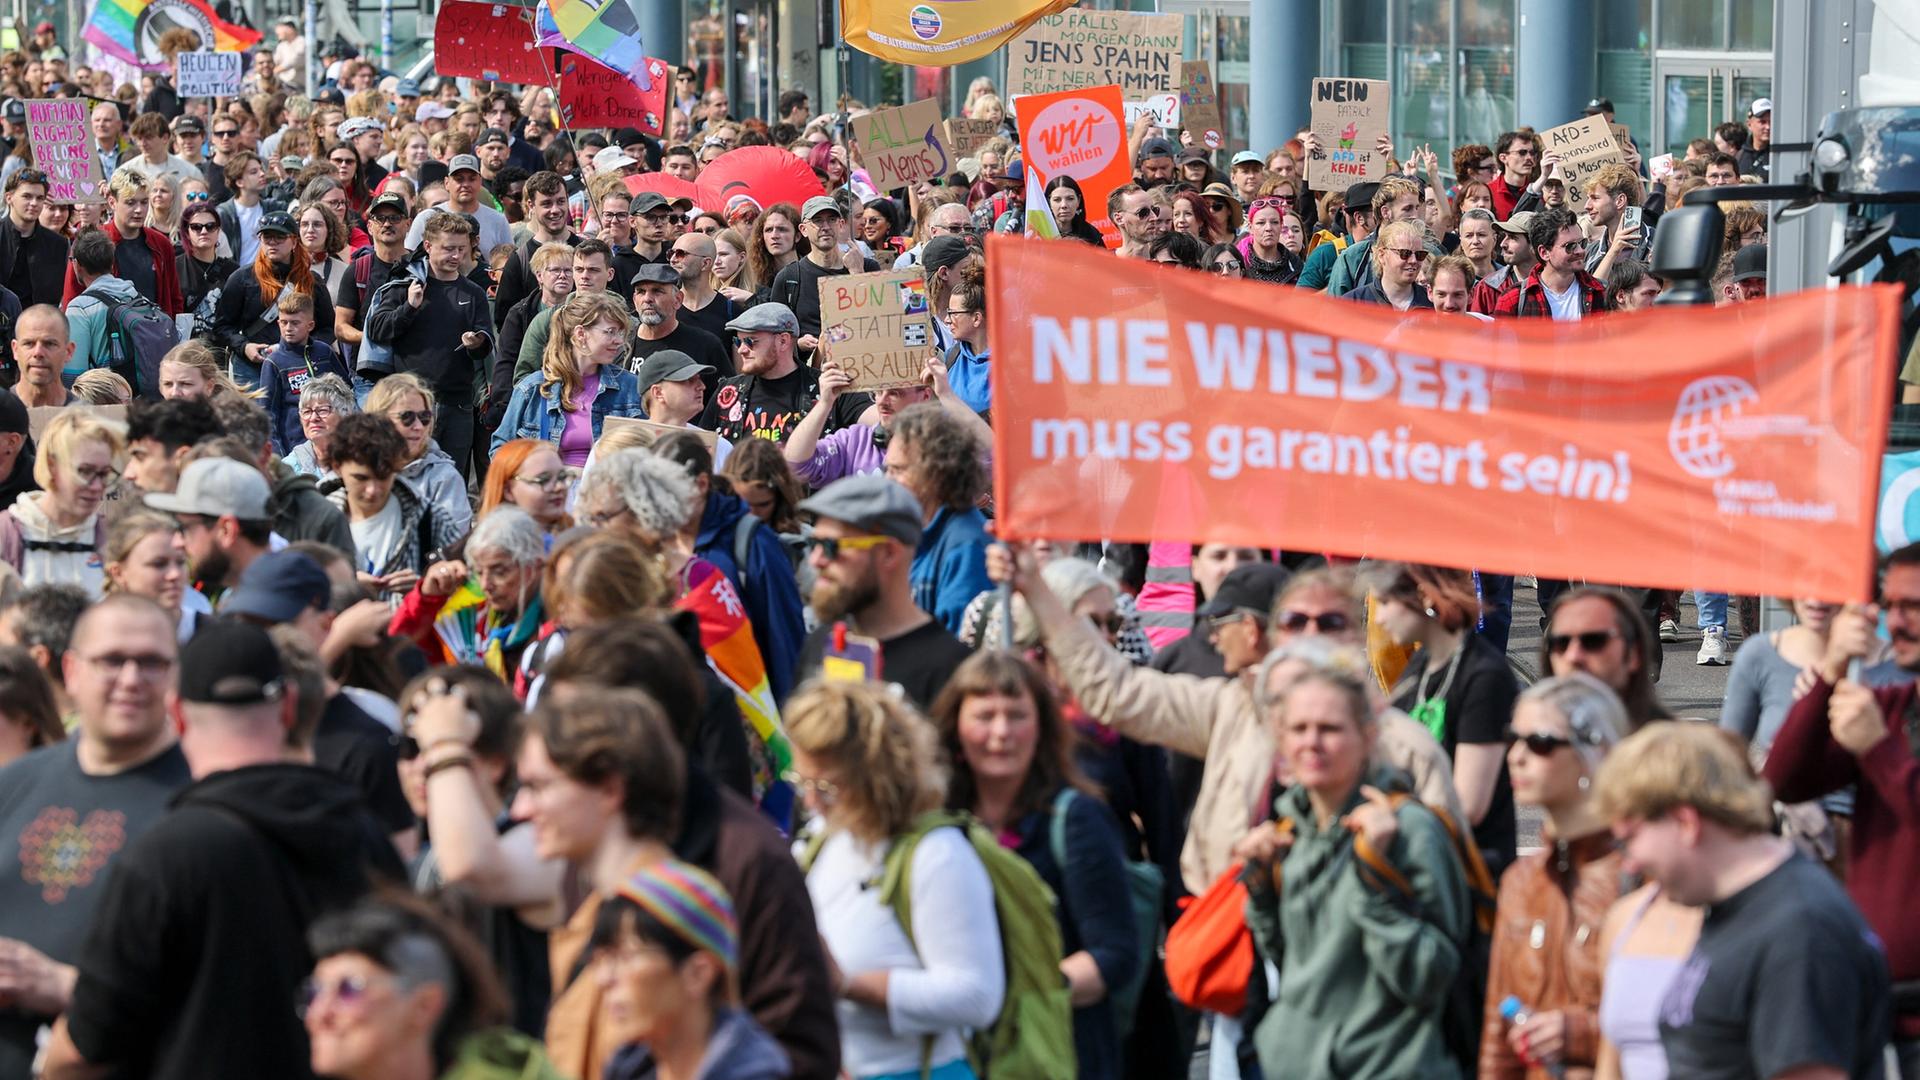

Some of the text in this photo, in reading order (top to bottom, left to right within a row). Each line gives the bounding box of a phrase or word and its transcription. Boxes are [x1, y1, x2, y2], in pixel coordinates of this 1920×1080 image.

[1034, 14, 1119, 30] ND FALLS
[1060, 31, 1179, 48] MORGEN DANN
[180, 53, 237, 72] HEULEN
[1024, 40, 1170, 72] JENS SPAHN
[1063, 70, 1097, 85] NER
[180, 82, 236, 97] POLITIK
[1317, 80, 1369, 103] NEIN
[28, 102, 85, 123] HUMAN
[573, 94, 600, 118] Mehr
[1337, 105, 1371, 118] PATRICK
[33, 124, 88, 142] RIGHTS
[868, 108, 924, 150] ALL
[1039, 105, 1105, 155] wir
[1552, 125, 1580, 147] AfD
[37, 143, 90, 161] BELONG
[956, 136, 969, 150] IST
[1560, 138, 1609, 163] sponsored
[1049, 145, 1104, 170] wählen
[1313, 151, 1371, 162] Die AFD ist
[48, 162, 89, 180] EVERY
[1331, 162, 1367, 176] KEINE
[1563, 166, 1577, 182] by
[49, 182, 78, 200] ONE
[836, 280, 909, 311] BUNT
[842, 315, 905, 342] STATT
[842, 350, 924, 381] BRAUN
[1032, 316, 1490, 414] NIE WIEDER
[288, 372, 309, 384] FCK
[290, 380, 307, 391] NZ
[1031, 418, 1631, 503] muss garantiert sein!
